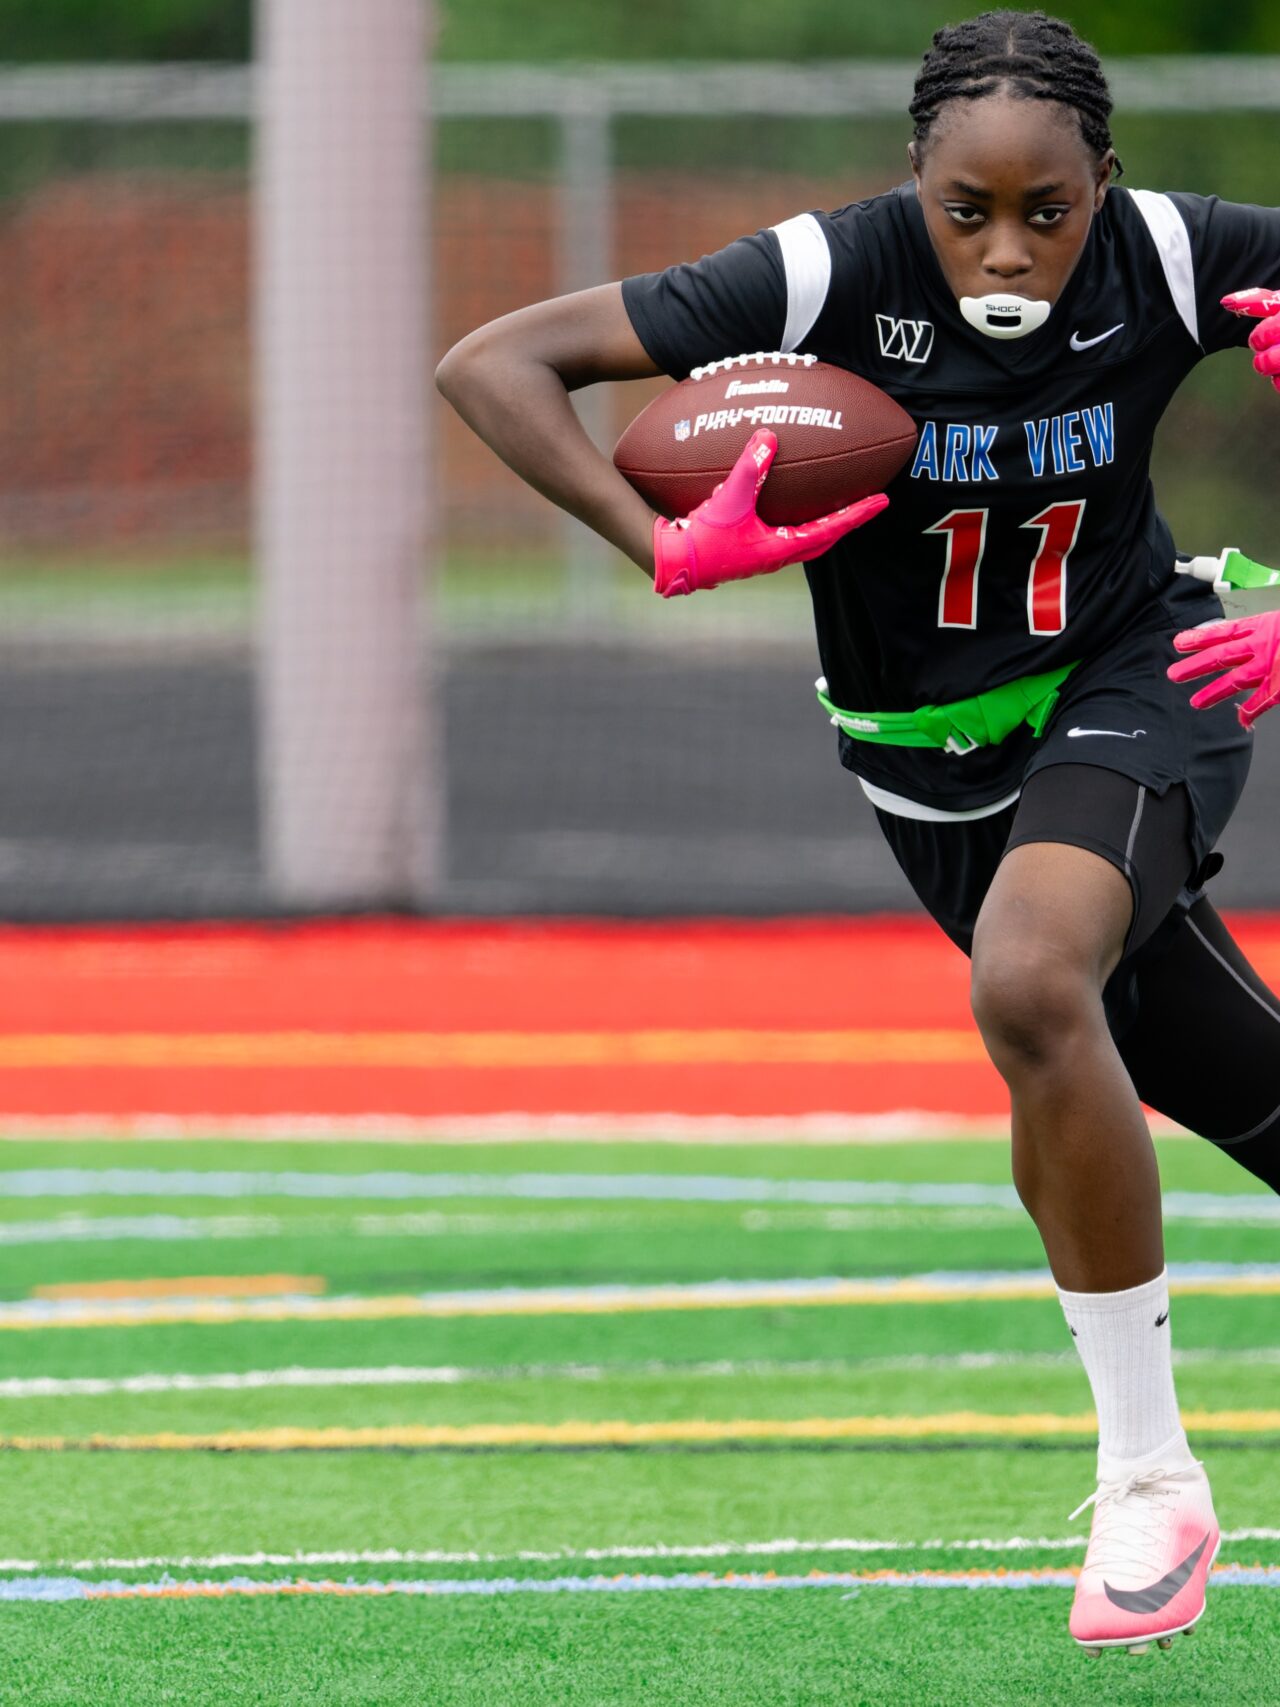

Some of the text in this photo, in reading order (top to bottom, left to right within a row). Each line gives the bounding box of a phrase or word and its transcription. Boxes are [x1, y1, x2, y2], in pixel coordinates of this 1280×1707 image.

[985, 303, 1022, 313] SHOCK
[693, 407, 744, 437] PLAY
[750, 405, 843, 431] FOOTBALL
[910, 402, 1114, 482] ARK VIEW
[921, 499, 1087, 637] 11
